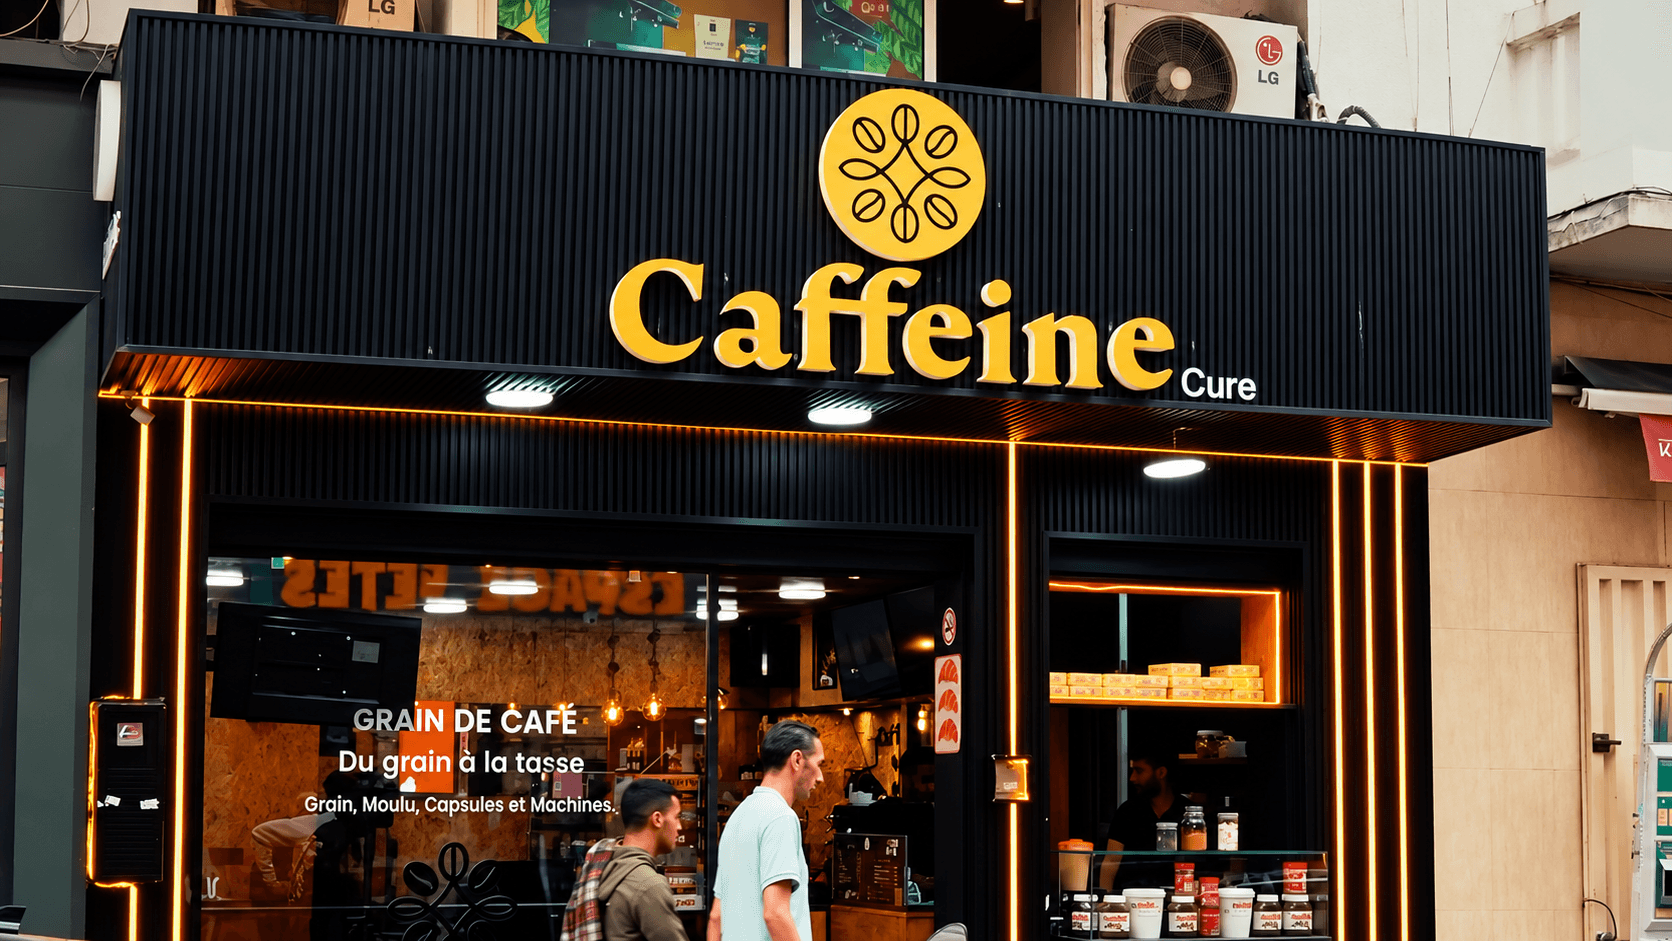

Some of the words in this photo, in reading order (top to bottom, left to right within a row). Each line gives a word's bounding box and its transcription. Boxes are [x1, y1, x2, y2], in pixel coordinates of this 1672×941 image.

[369, 0, 395, 15] LG
[1258, 69, 1279, 85] LG
[609, 258, 1175, 391] Caffeine
[1181, 367, 1257, 401] Cure
[353, 708, 444, 732] GRAIN
[455, 708, 492, 733] DE
[500, 702, 578, 735] CAFÉ
[339, 750, 374, 773] Du
[382, 749, 451, 780] grain
[459, 750, 476, 773] à
[484, 750, 508, 773] la
[515, 753, 585, 774] tasse
[305, 794, 358, 815] Grain,
[362, 796, 420, 816] Moulu,
[424, 795, 504, 817] Capsules
[508, 797, 526, 813] et
[530, 795, 617, 814] Machines.
